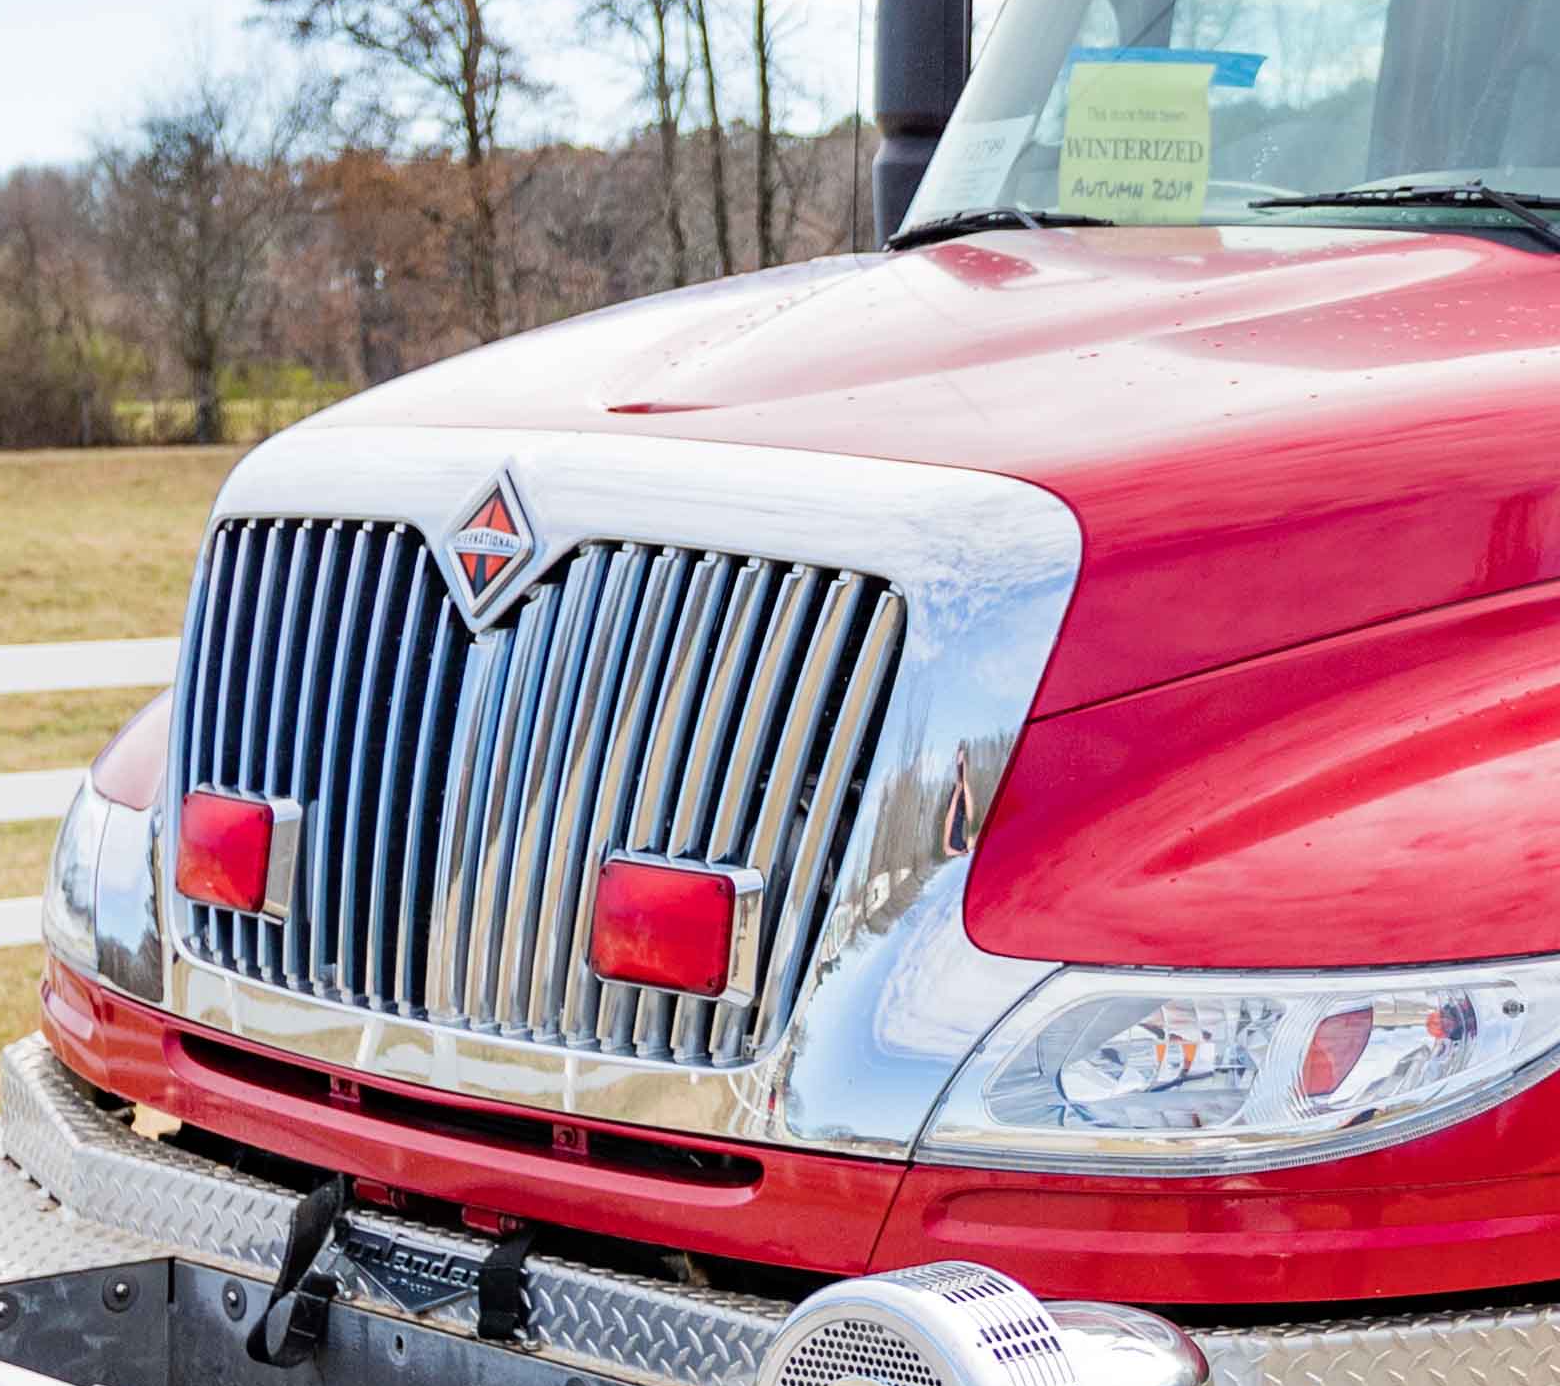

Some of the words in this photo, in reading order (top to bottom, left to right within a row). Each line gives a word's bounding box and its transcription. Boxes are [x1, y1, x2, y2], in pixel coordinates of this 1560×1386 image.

[1066, 136, 1205, 164] WINTERIZED
[1071, 177, 1145, 200] AUTUMN
[1151, 178, 1193, 201] 2019
[456, 531, 515, 548] NTERNATIONAL
